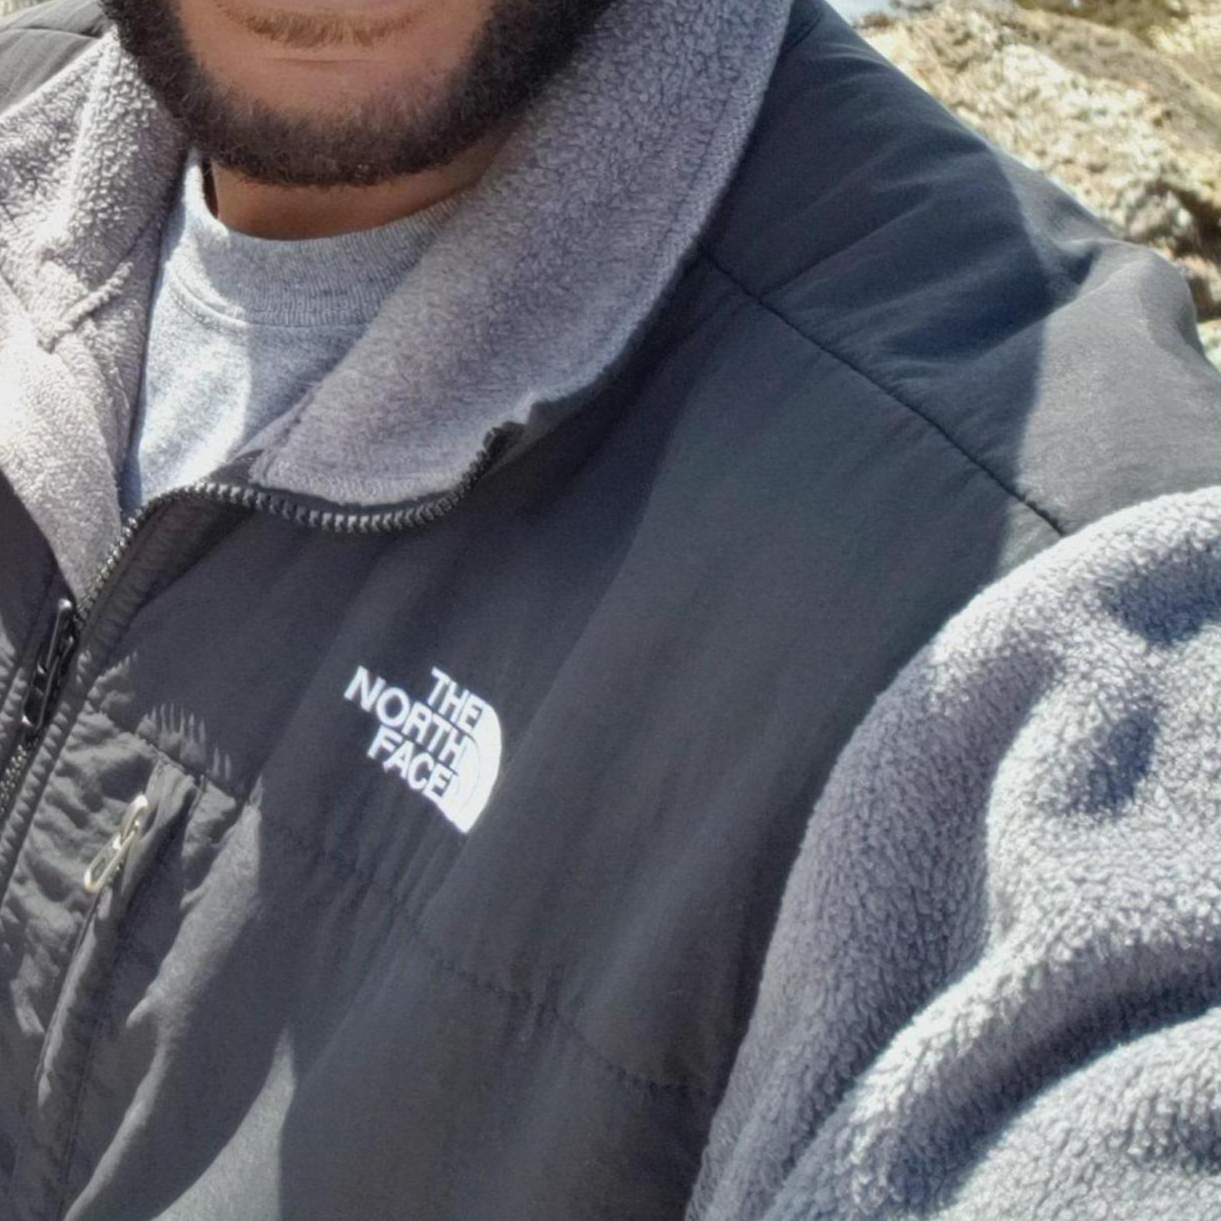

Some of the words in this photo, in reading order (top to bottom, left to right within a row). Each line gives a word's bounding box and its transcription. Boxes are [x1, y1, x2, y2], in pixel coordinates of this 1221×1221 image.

[344, 665, 468, 769] NORTH
[427, 666, 485, 732] THE
[367, 725, 457, 800] FACE
